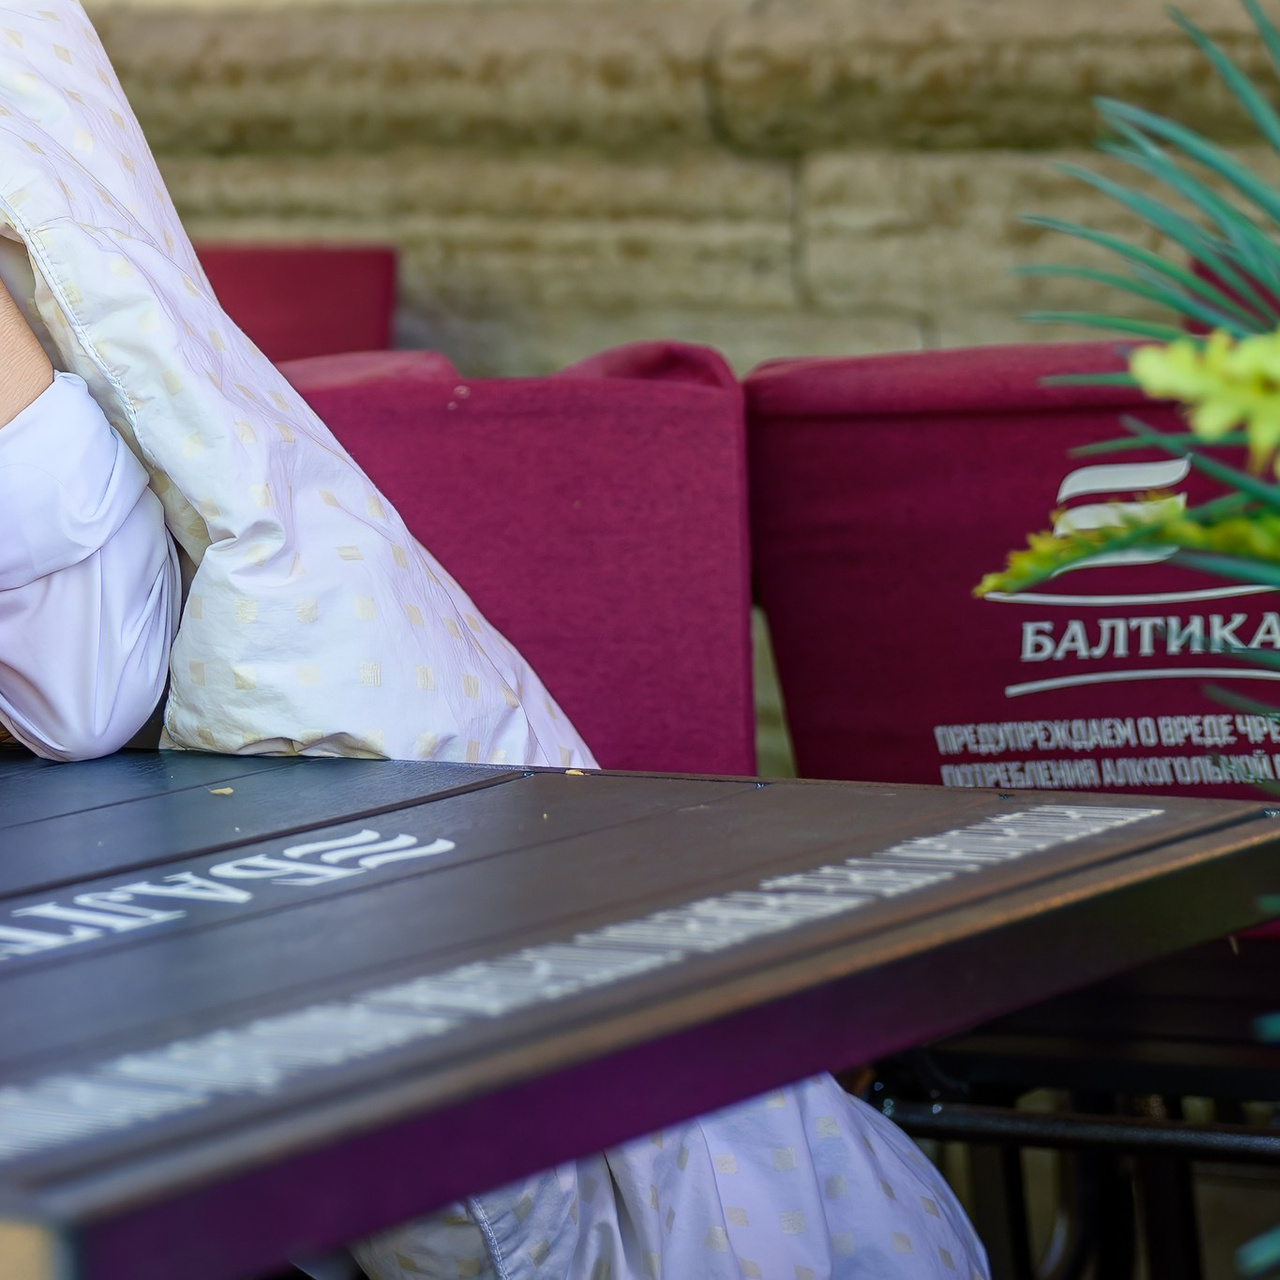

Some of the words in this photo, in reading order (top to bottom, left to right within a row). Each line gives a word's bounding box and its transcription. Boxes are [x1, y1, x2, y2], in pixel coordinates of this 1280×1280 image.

[1021, 611, 1280, 662] БАЛТИКА
[933, 717, 1139, 755] ПРЕДУПРЕЖДАЕМ
[1138, 716, 1158, 747] О
[1157, 714, 1237, 748] ВРЕДЕ
[940, 759, 1100, 788] ПОТРЕБЛЕНИЯ
